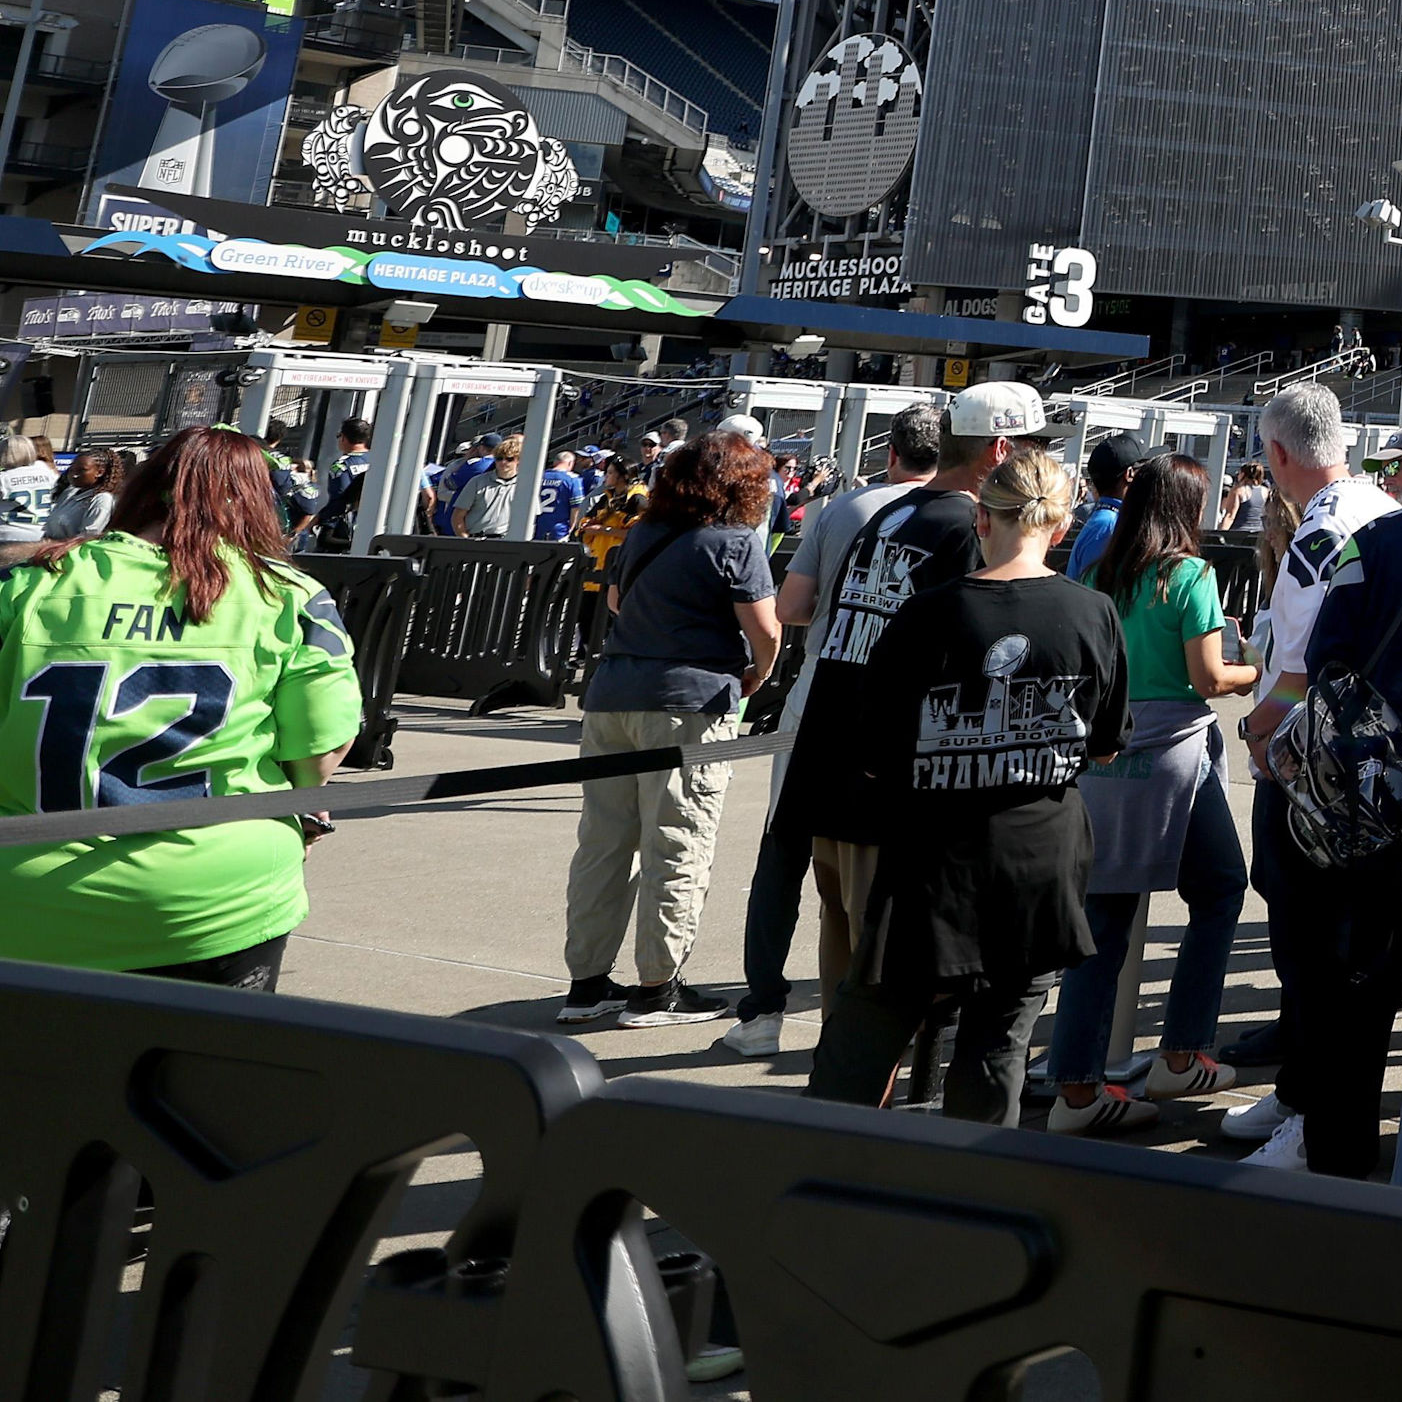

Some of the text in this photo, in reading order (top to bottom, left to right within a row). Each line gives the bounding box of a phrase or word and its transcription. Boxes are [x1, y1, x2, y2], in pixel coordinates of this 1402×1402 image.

[158, 167, 181, 182] NFL
[220, 248, 335, 272] Green River
[373, 263, 497, 288] HERITAGE PLAZA
[1022, 242, 1098, 328] GATE 3
[770, 273, 913, 300] HERITAGE PLAZA
[24, 308, 54, 326] Tito's
[86, 304, 116, 322] Tito's
[150, 300, 181, 318] Tito's
[961, 298, 999, 317] DOGS
[291, 374, 379, 385] NO FIREARMS NO KNIVES
[451, 382, 529, 394] NO FIREARMS NO KNIVES
[11, 475, 50, 488] SHERMAN
[102, 602, 189, 642] FAN
[20, 660, 237, 815] 12
[938, 727, 1069, 748] SUPER BOWL
[912, 741, 1088, 790] CHAMPIONS
